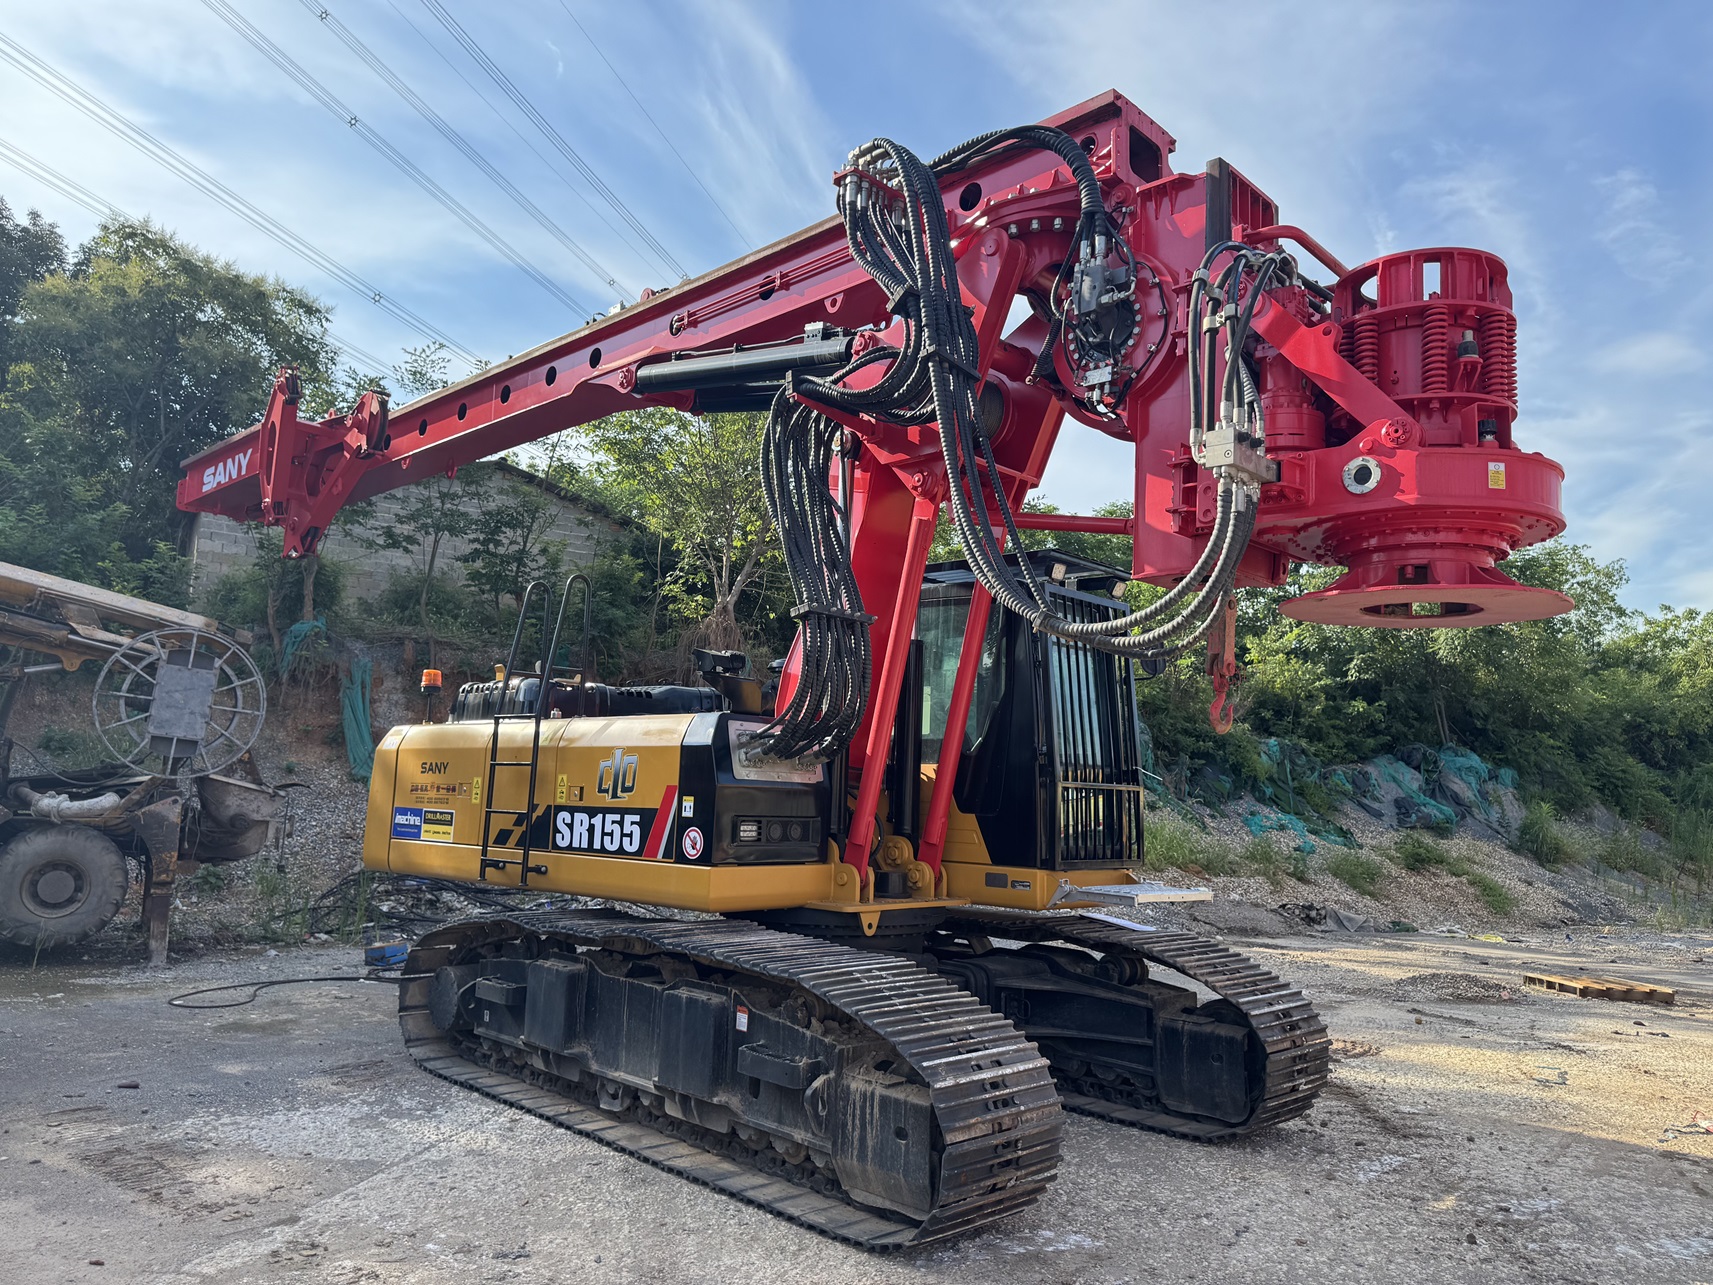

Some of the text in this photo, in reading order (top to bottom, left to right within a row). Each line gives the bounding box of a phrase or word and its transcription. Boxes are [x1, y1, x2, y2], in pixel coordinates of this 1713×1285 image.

[202, 448, 253, 492] SANY
[420, 761, 449, 774] SANY
[555, 811, 641, 852] SR155
